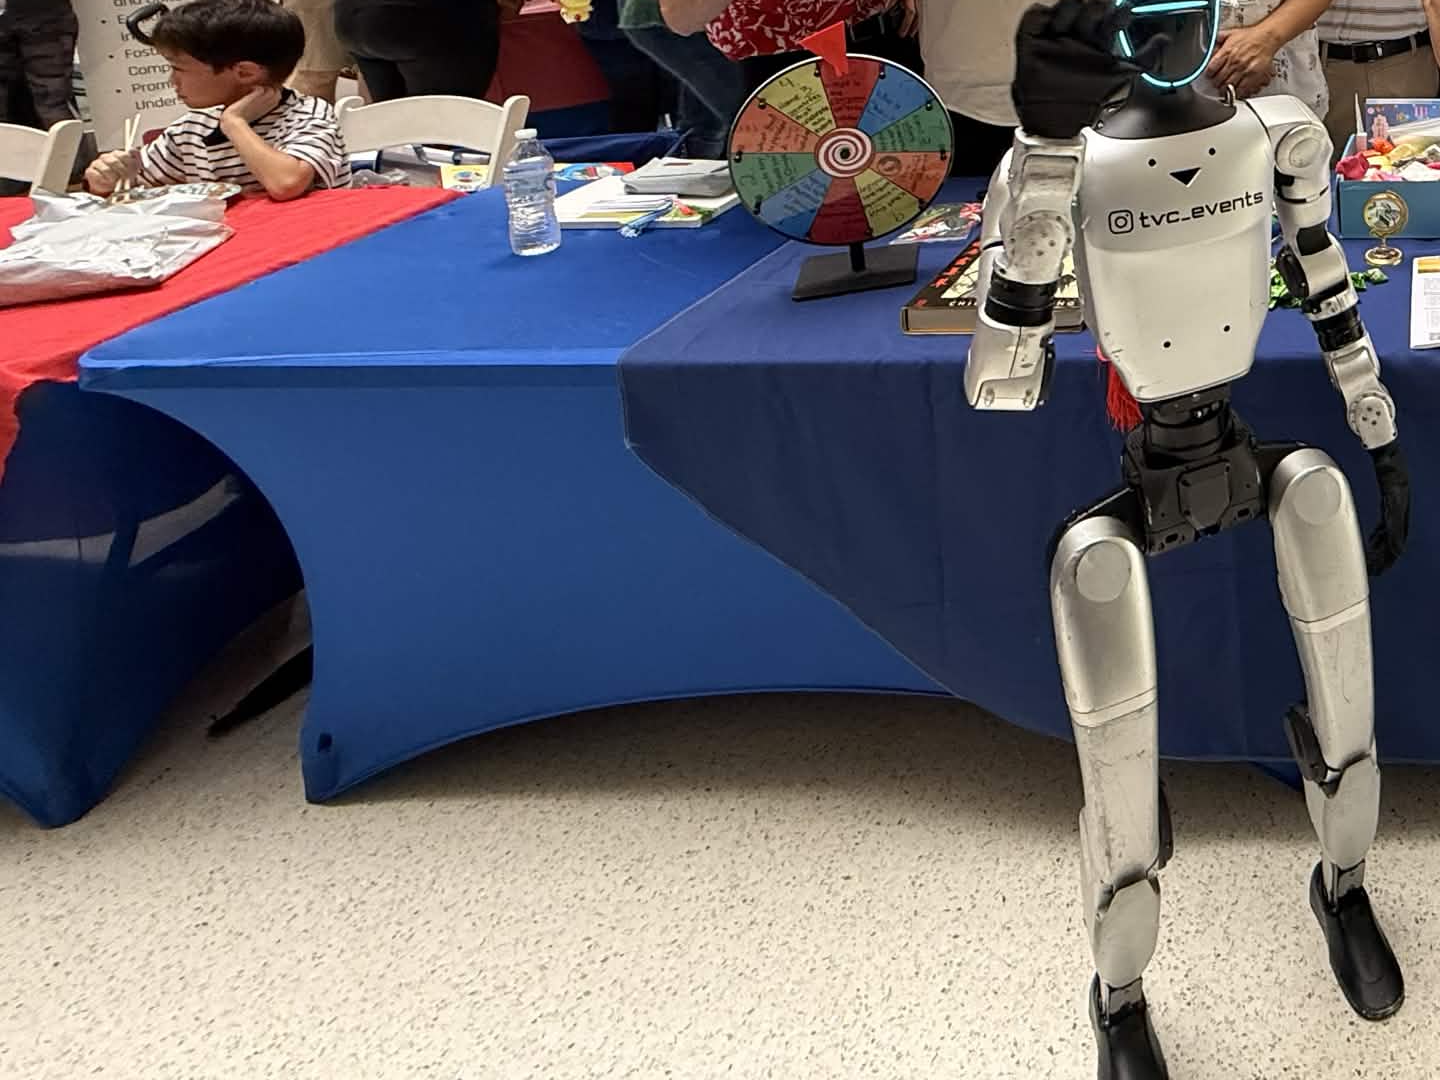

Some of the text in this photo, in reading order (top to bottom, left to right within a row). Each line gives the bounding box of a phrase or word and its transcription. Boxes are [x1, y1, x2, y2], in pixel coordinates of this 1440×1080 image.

[128, 63, 173, 77] Comp
[131, 81, 173, 94] Prom
[135, 96, 178, 110] Under
[1139, 191, 1263, 228] tvc_events
